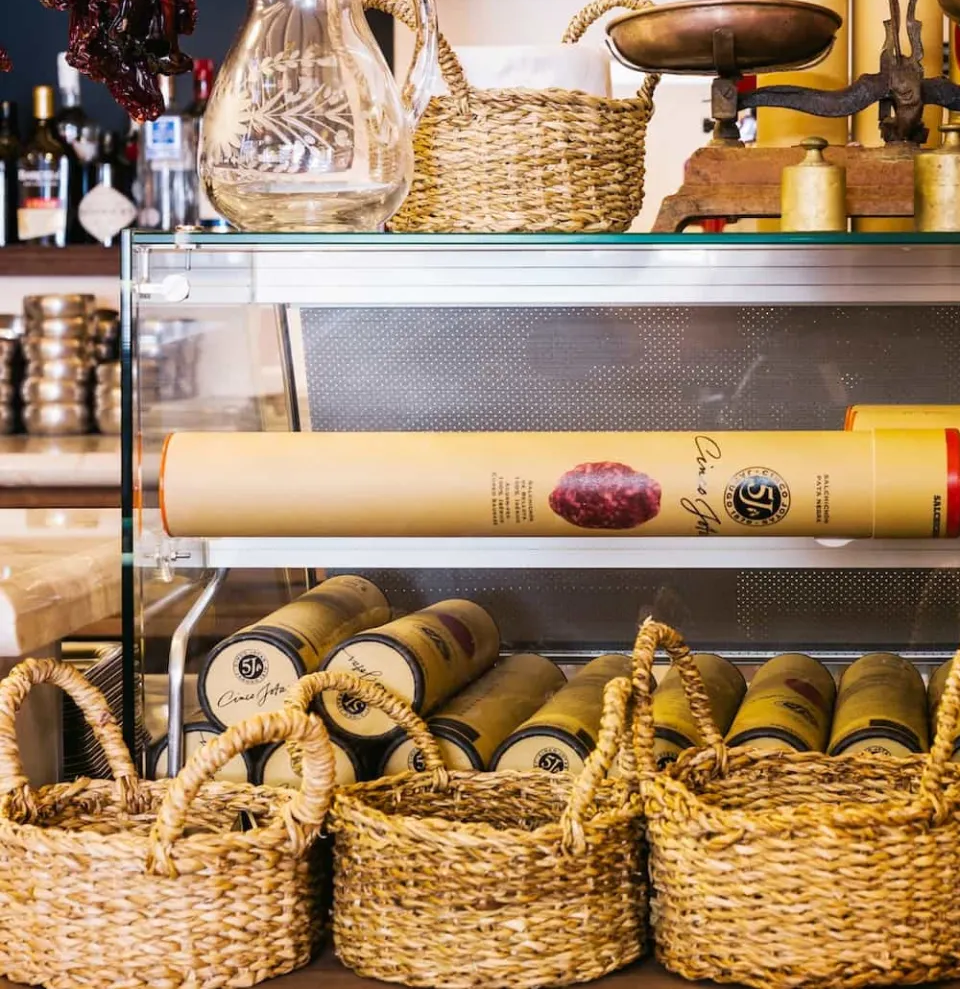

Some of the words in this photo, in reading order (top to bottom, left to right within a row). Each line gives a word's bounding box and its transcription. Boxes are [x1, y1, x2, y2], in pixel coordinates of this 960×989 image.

[738, 482, 775, 512] 5J
[241, 657, 258, 678] 5J
[256, 682, 287, 707] Jota
